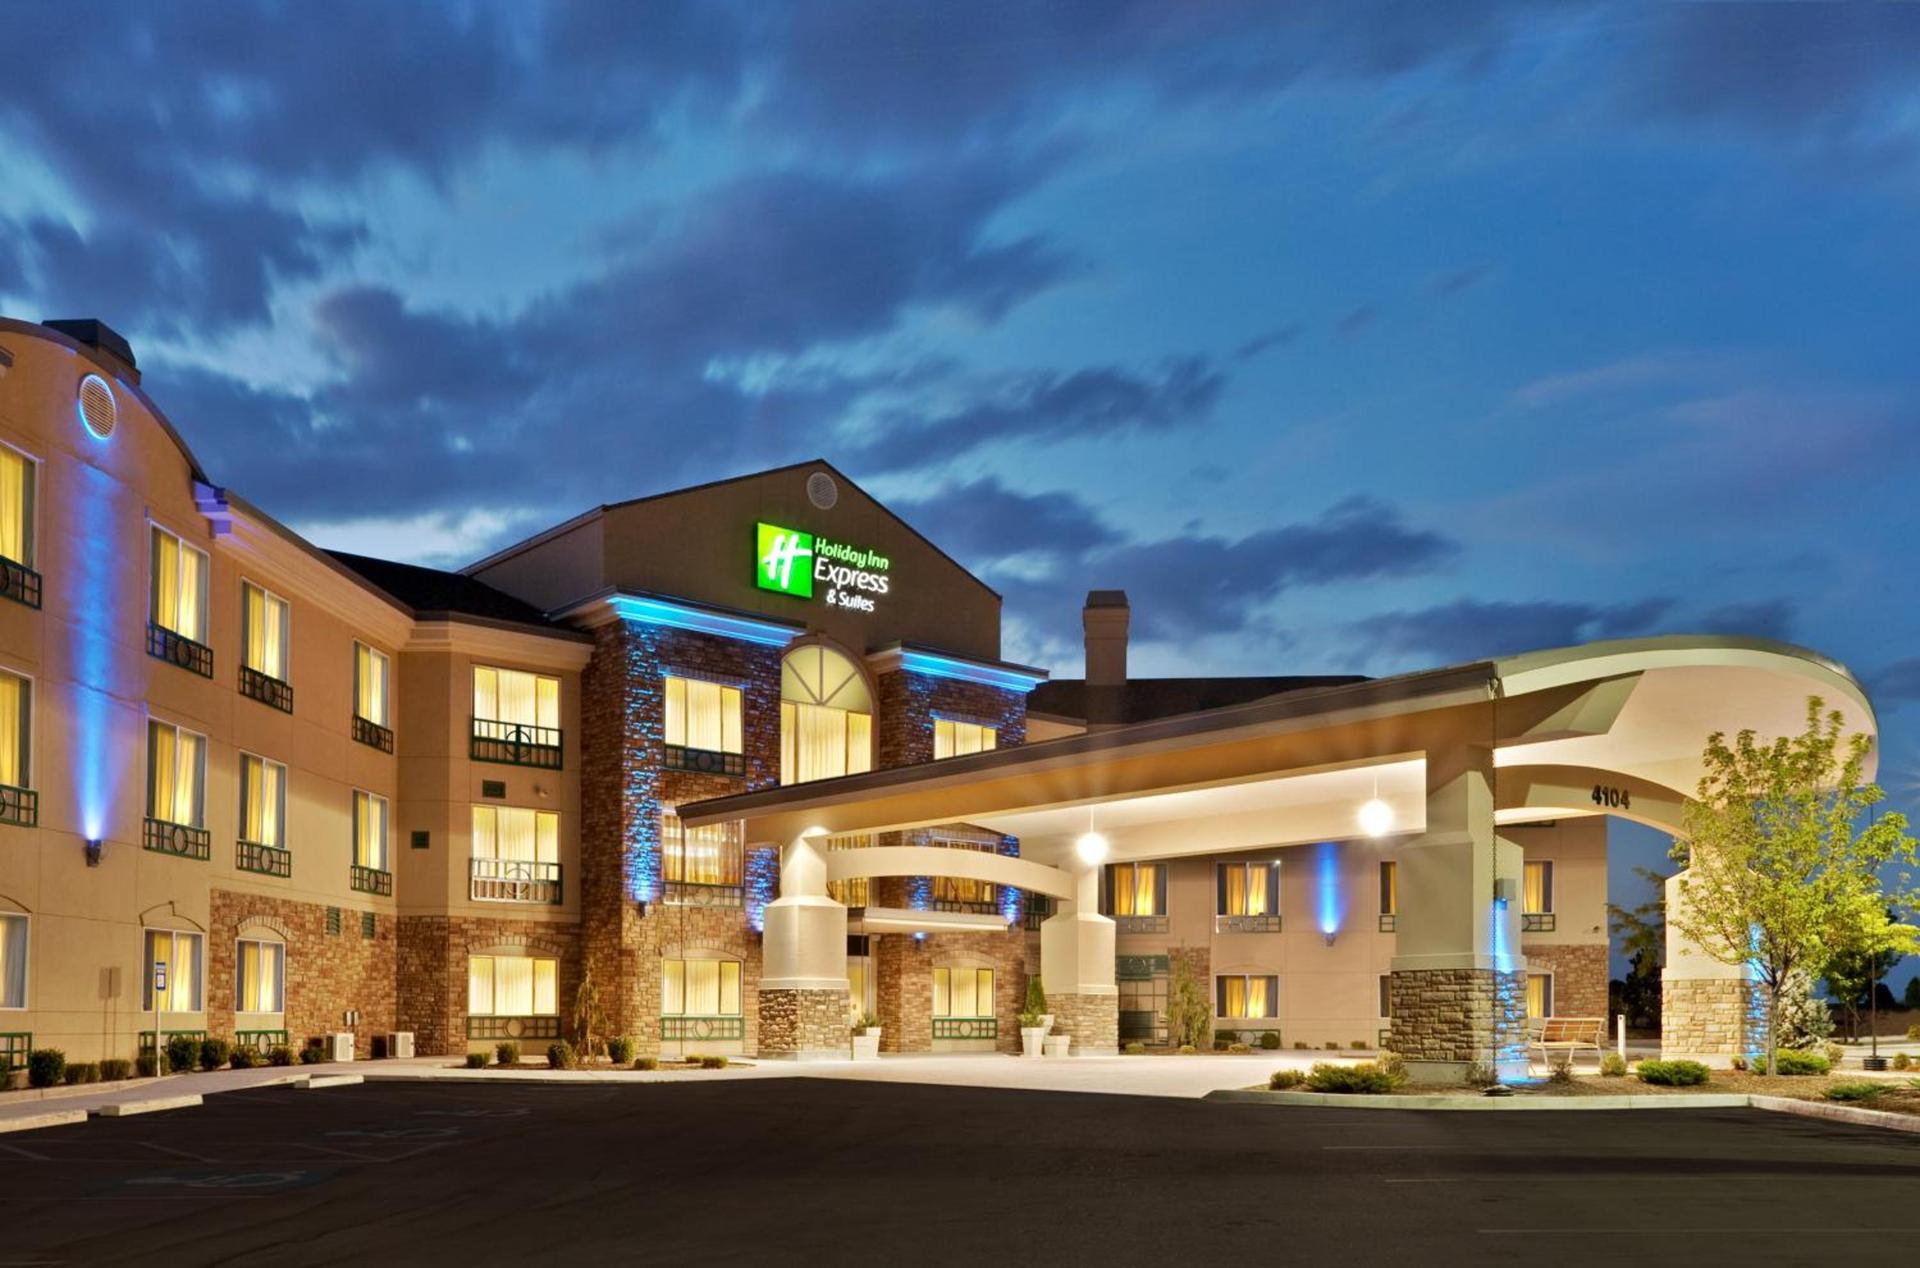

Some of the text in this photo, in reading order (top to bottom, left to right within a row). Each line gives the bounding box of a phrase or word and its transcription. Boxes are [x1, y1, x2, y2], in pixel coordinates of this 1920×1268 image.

[815, 537, 889, 570] Holiday Inn
[814, 557, 889, 594] Express
[826, 589, 875, 612] & Suites
[1592, 785, 1630, 809] 4104
